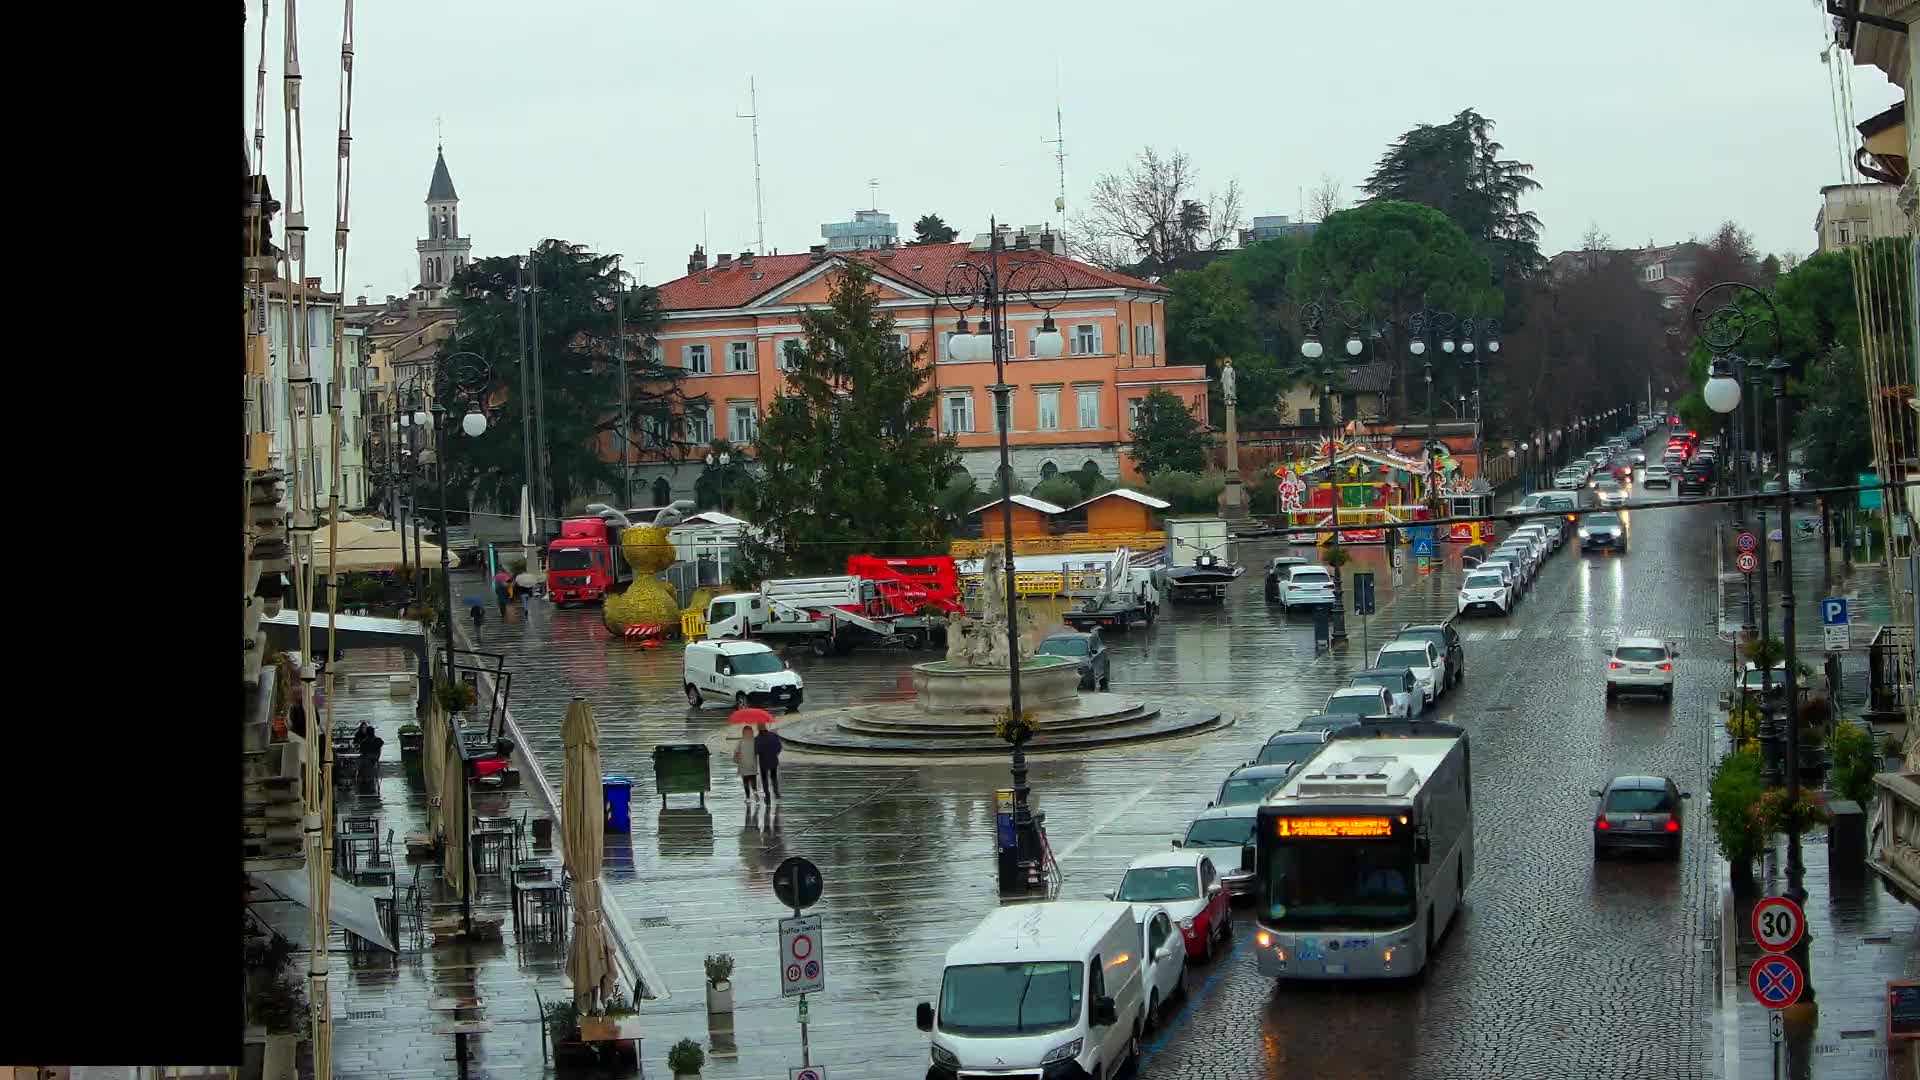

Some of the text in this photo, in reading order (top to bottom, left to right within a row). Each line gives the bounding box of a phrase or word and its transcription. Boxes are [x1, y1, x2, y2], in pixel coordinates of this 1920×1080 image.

[1743, 558, 1753, 567] 20
[1827, 602, 1842, 622] P
[1279, 818, 1291, 837] 1
[1762, 911, 1792, 938] 30
